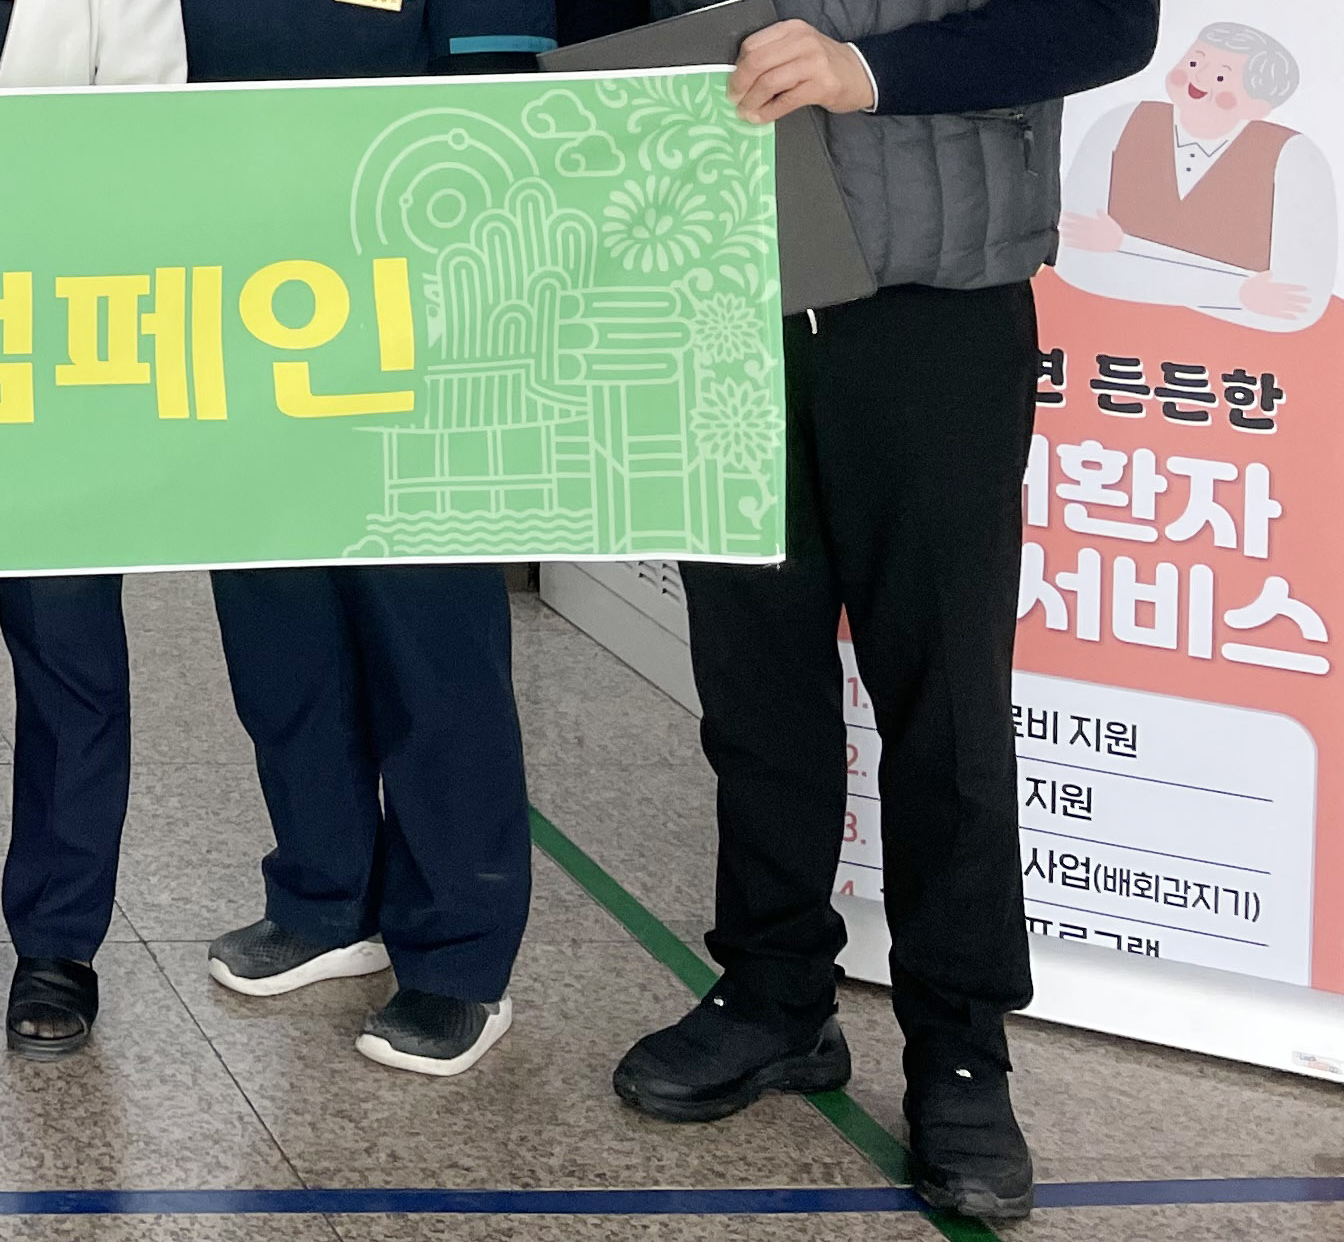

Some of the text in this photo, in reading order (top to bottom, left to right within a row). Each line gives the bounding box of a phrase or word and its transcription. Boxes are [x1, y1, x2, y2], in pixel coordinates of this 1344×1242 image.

[1089, 354, 1286, 433] 든든한
[1069, 714, 1138, 758] 지원
[1025, 776, 1093, 821] 지원
